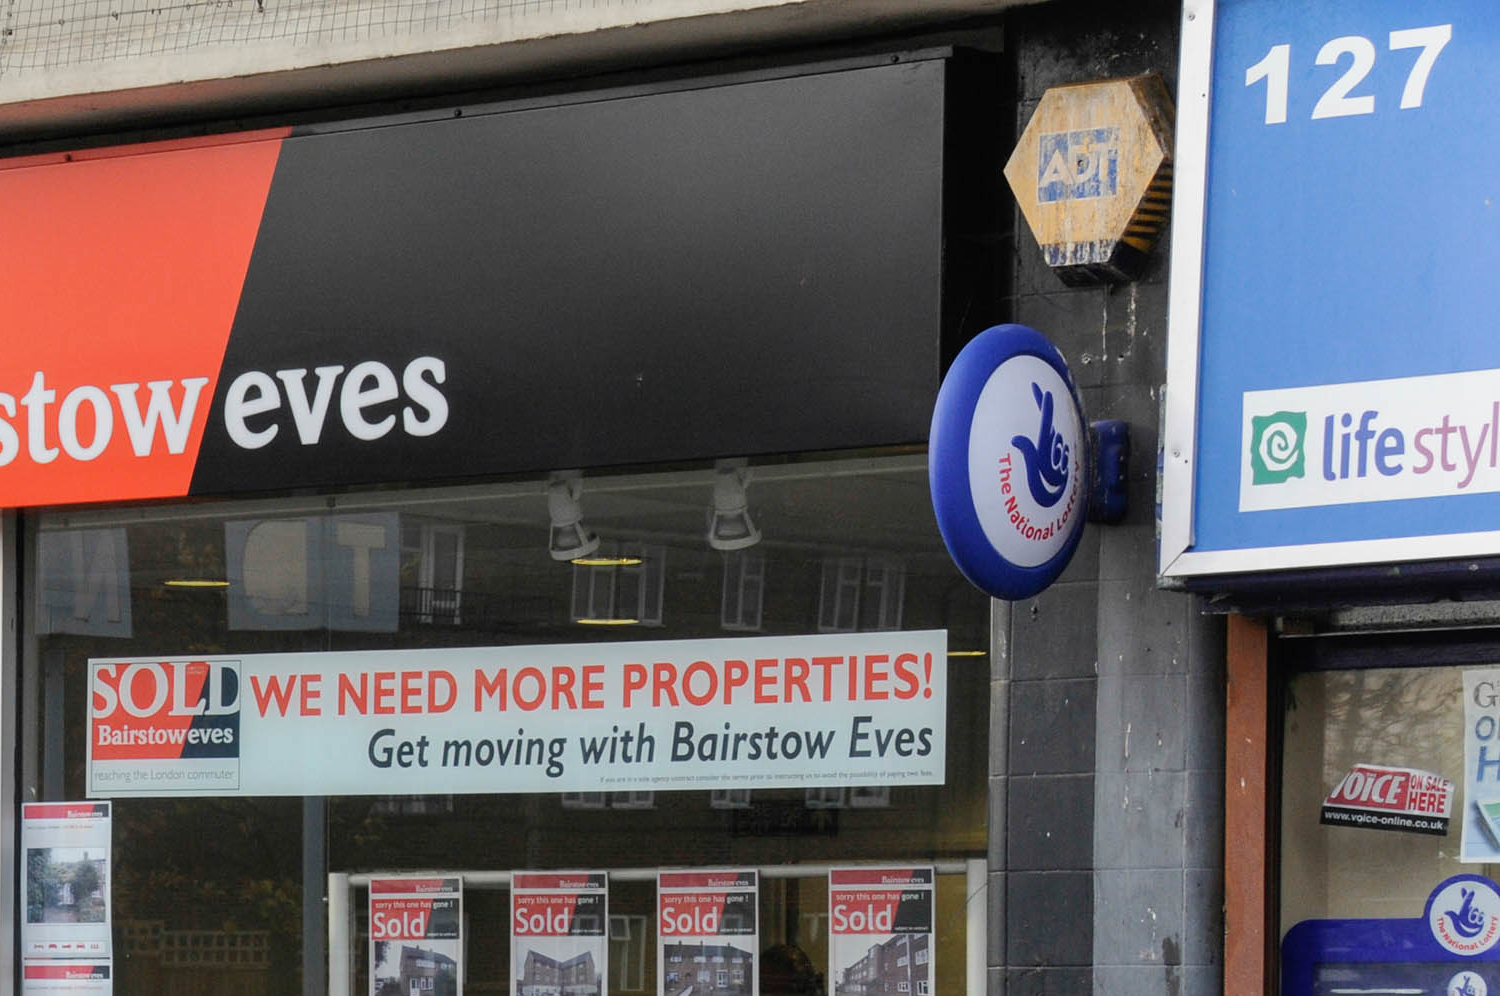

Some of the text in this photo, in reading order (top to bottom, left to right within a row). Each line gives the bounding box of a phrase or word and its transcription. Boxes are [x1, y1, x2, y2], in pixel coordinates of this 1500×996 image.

[1245, 24, 1452, 125] 127
[1040, 143, 1118, 188] ADT
[223, 356, 449, 448] eves
[999, 453, 1012, 495] The
[1005, 496, 1053, 540] National
[92, 662, 240, 718] SOLD
[250, 652, 932, 718] WE NEED MORE PROPERTIES!
[368, 716, 933, 778] Get moving with Bairstow Eves
[94, 767, 234, 783] reaching the London commuter
[1410, 775, 1449, 792] ON SALE
[1408, 792, 1446, 813] HERE
[1324, 811, 1444, 830] www.voice-online.co.uk
[373, 911, 425, 938] Sold
[515, 907, 569, 933] Sold
[662, 906, 718, 933] Sold
[834, 903, 892, 931] Sold
